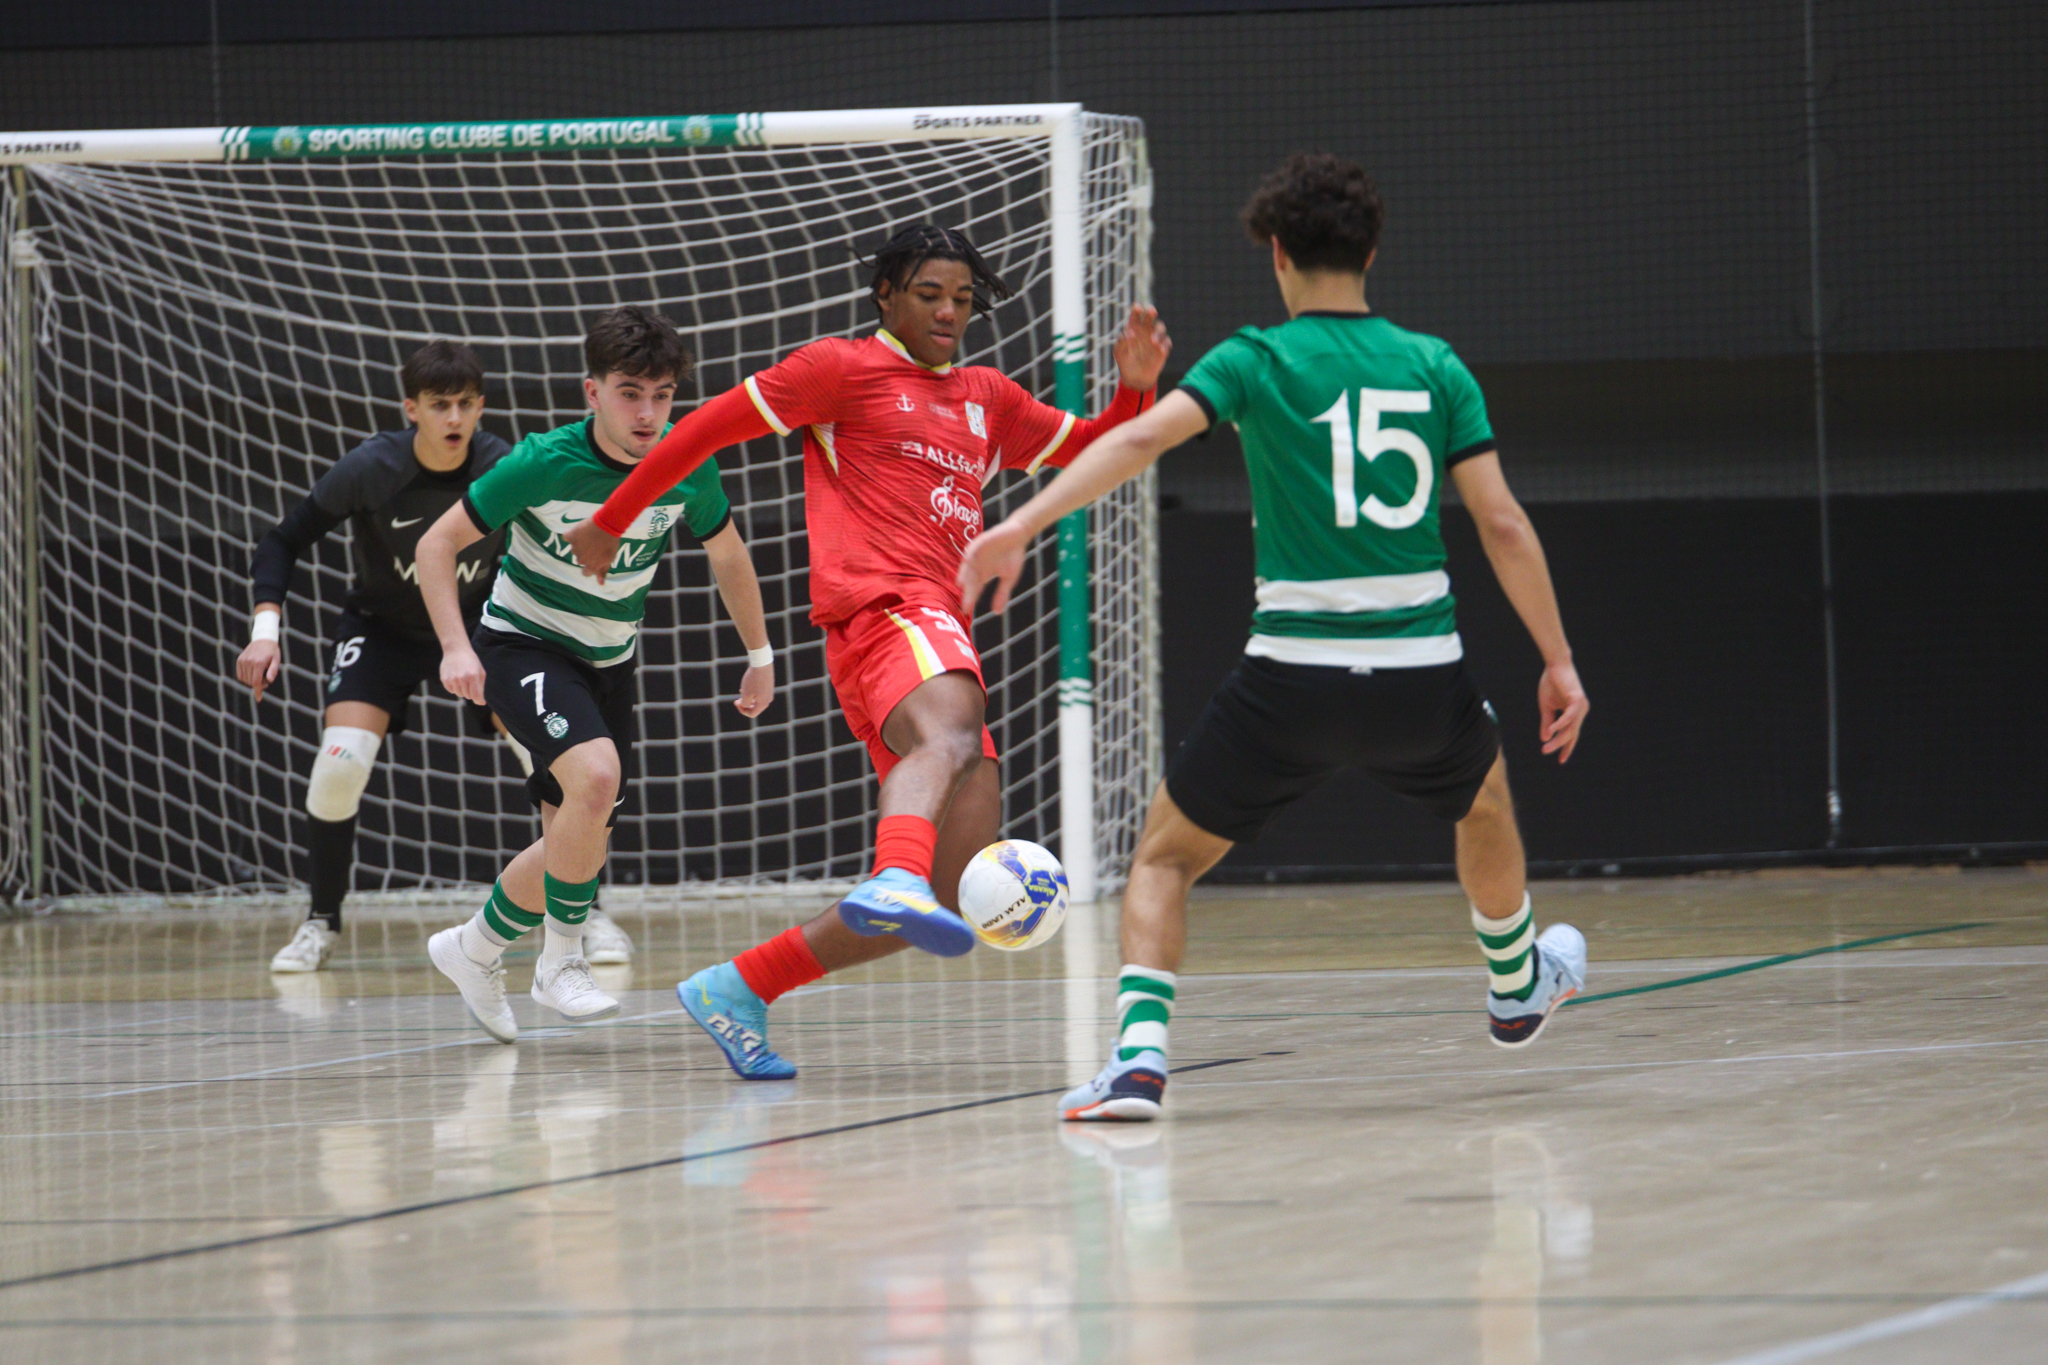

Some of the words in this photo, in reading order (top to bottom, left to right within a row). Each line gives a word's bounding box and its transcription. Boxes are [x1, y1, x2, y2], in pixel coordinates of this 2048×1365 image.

[308, 126, 425, 152] SPORTING
[429, 124, 508, 149] CLUBE
[512, 123, 546, 147] DE
[549, 120, 676, 145] PORTUGAL
[913, 115, 970, 130] SPORTS
[974, 114, 1043, 127] PARTNER
[14, 142, 83, 154] PARTNER
[1308, 387, 1433, 529] 15
[519, 671, 547, 717] 7
